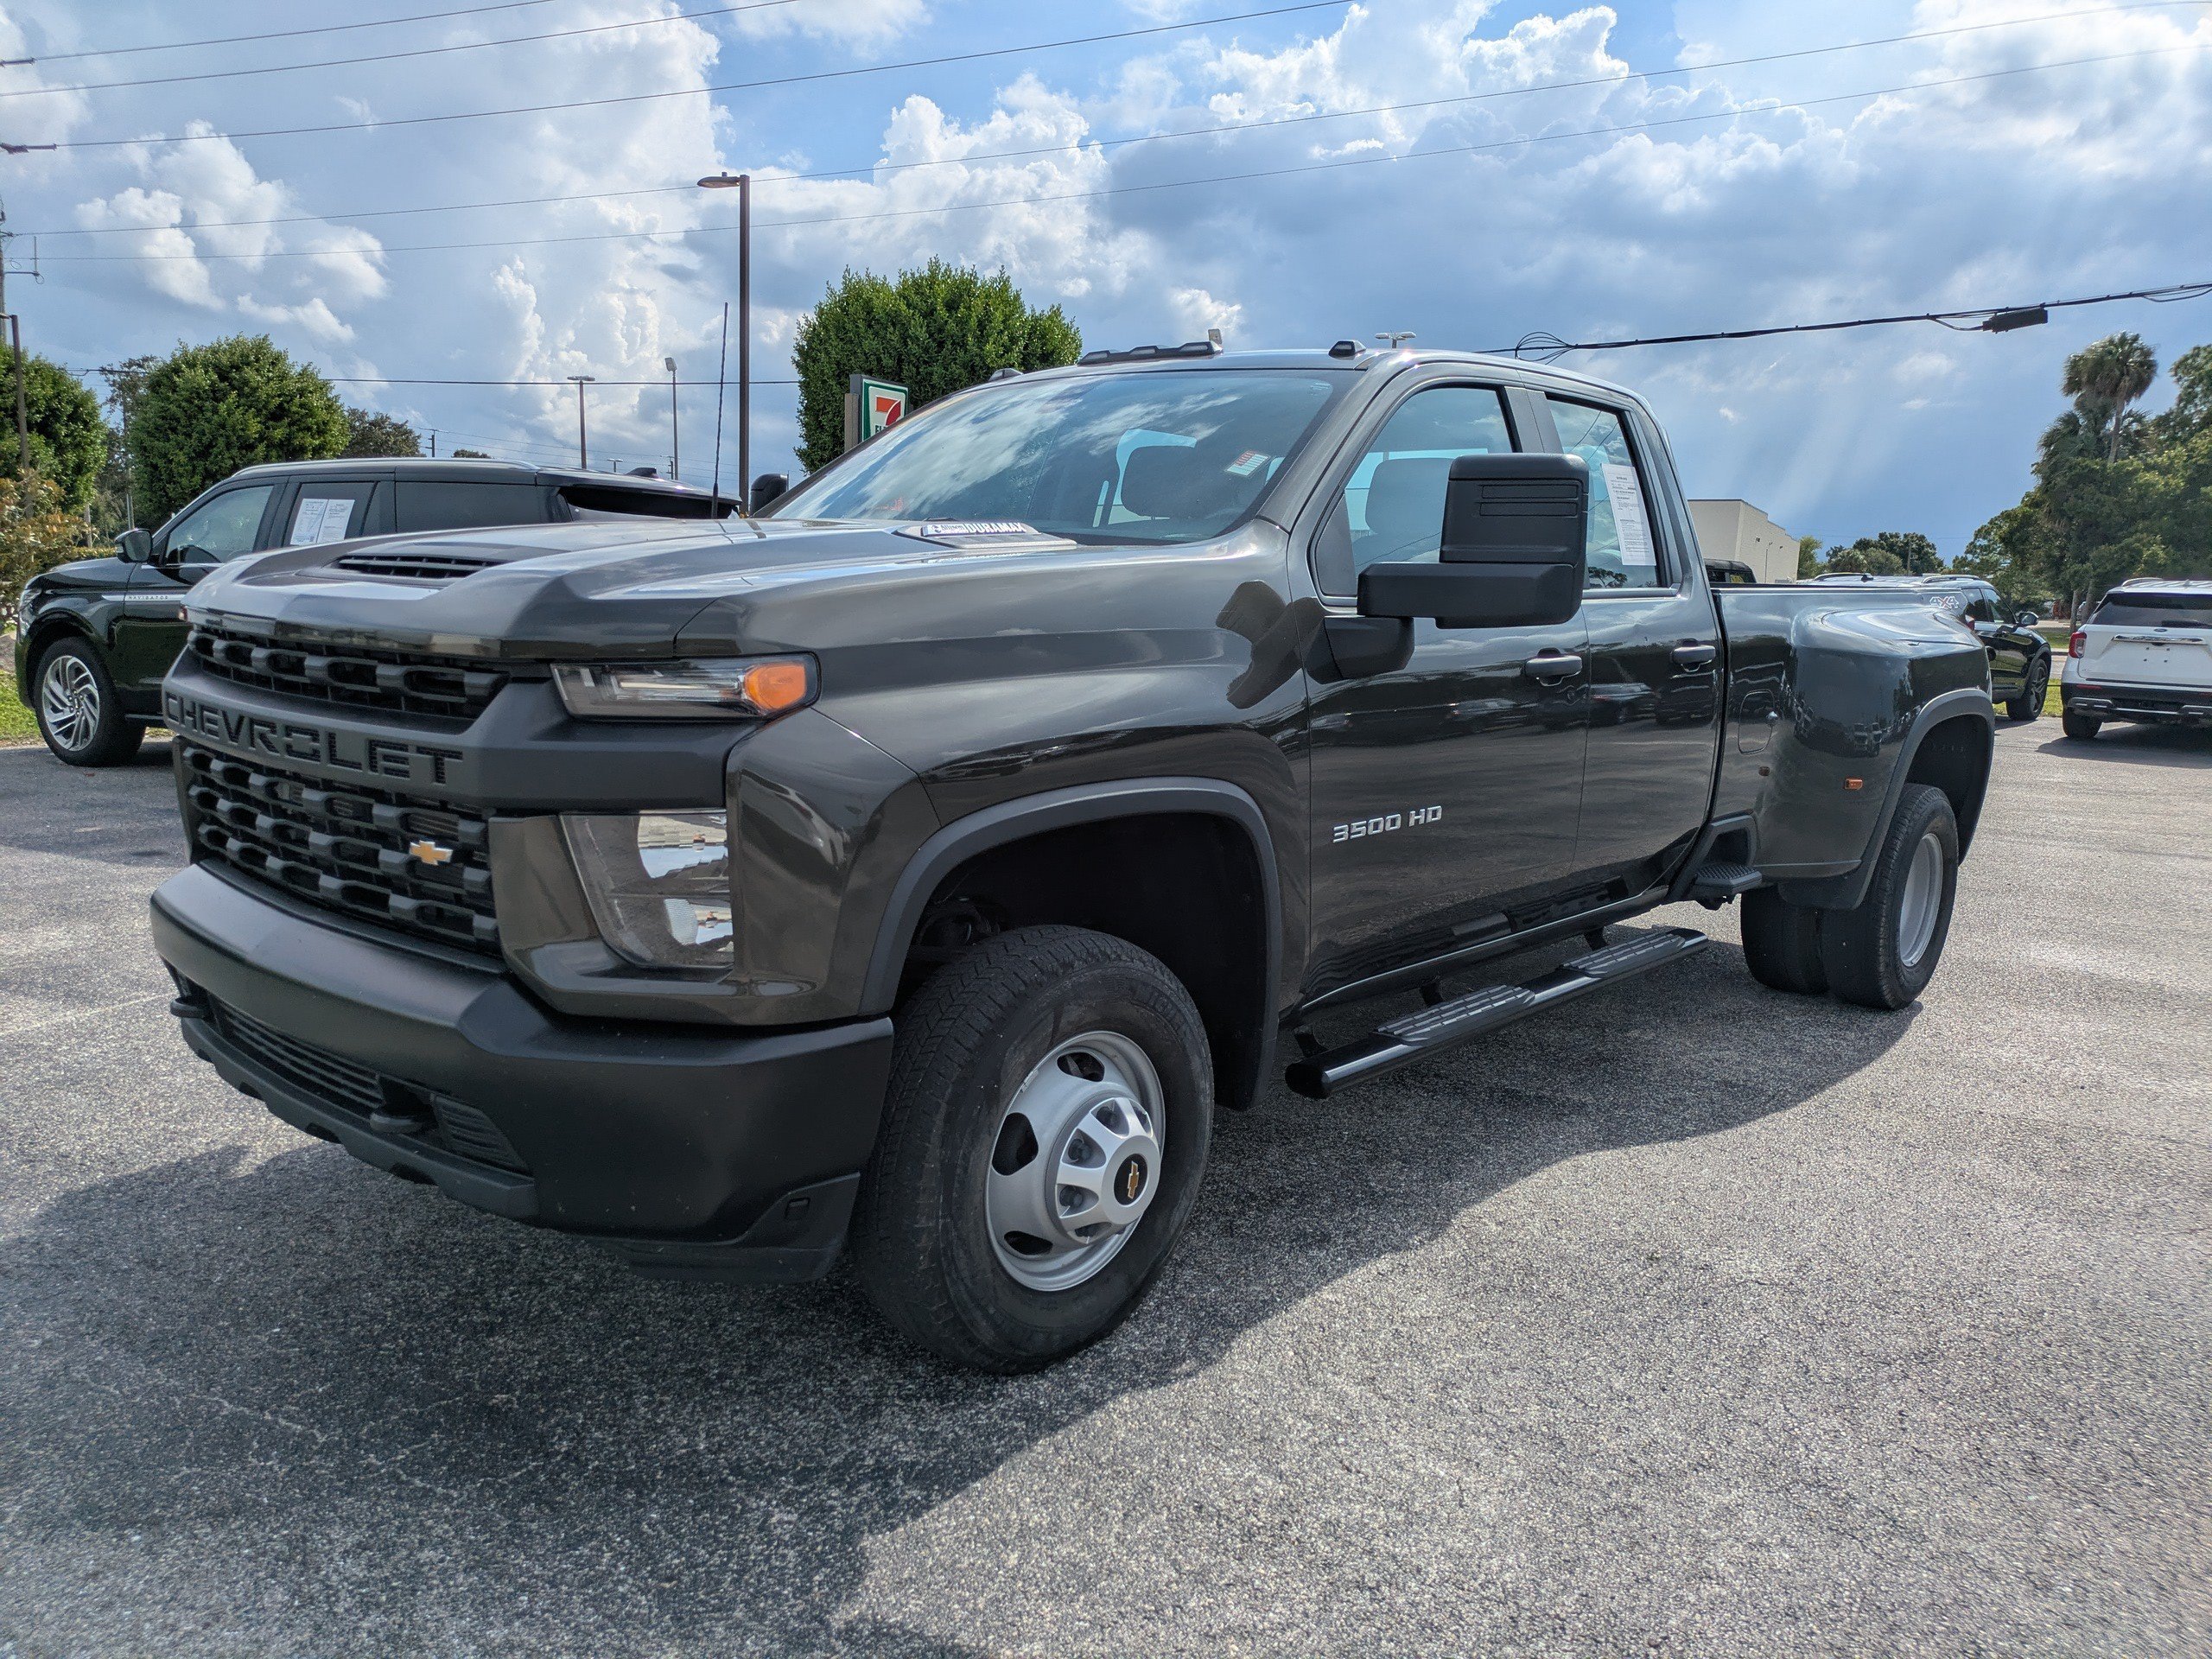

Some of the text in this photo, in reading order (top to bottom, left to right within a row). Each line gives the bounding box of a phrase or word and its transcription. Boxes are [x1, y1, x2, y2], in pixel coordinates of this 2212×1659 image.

[967, 522, 1027, 533] DURAMAX
[165, 691, 465, 785] CHEVROLET
[1332, 805, 1443, 843] 3500 HD
